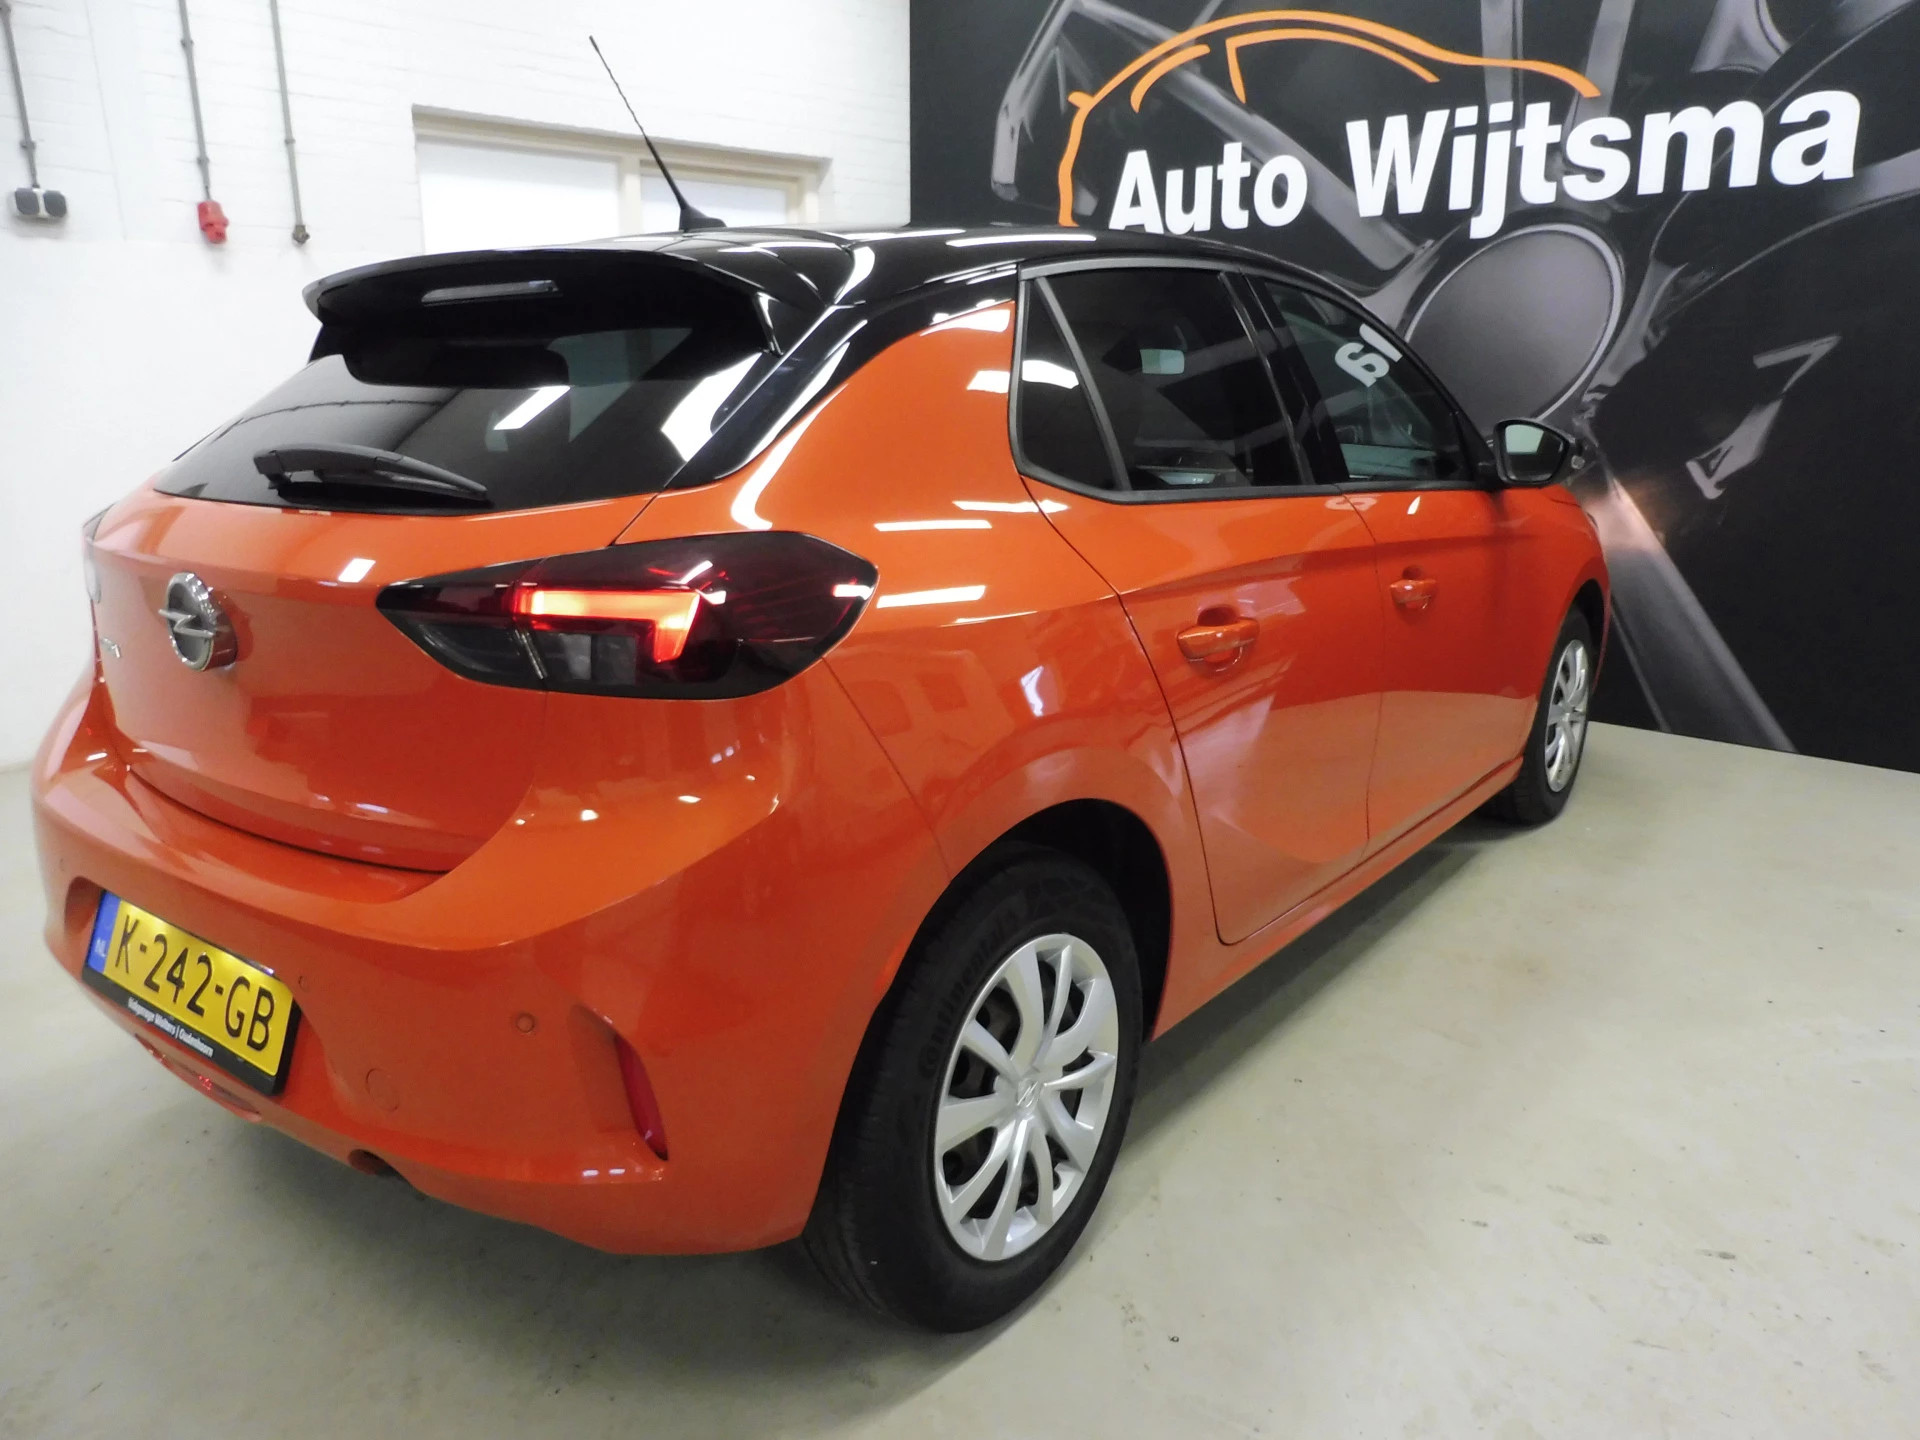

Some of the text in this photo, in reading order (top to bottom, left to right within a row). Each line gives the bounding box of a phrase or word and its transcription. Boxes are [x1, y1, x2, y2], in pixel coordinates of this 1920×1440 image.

[1109, 90, 1861, 239] Auto Wijtsma
[115, 915, 275, 1052] K-242-GB
